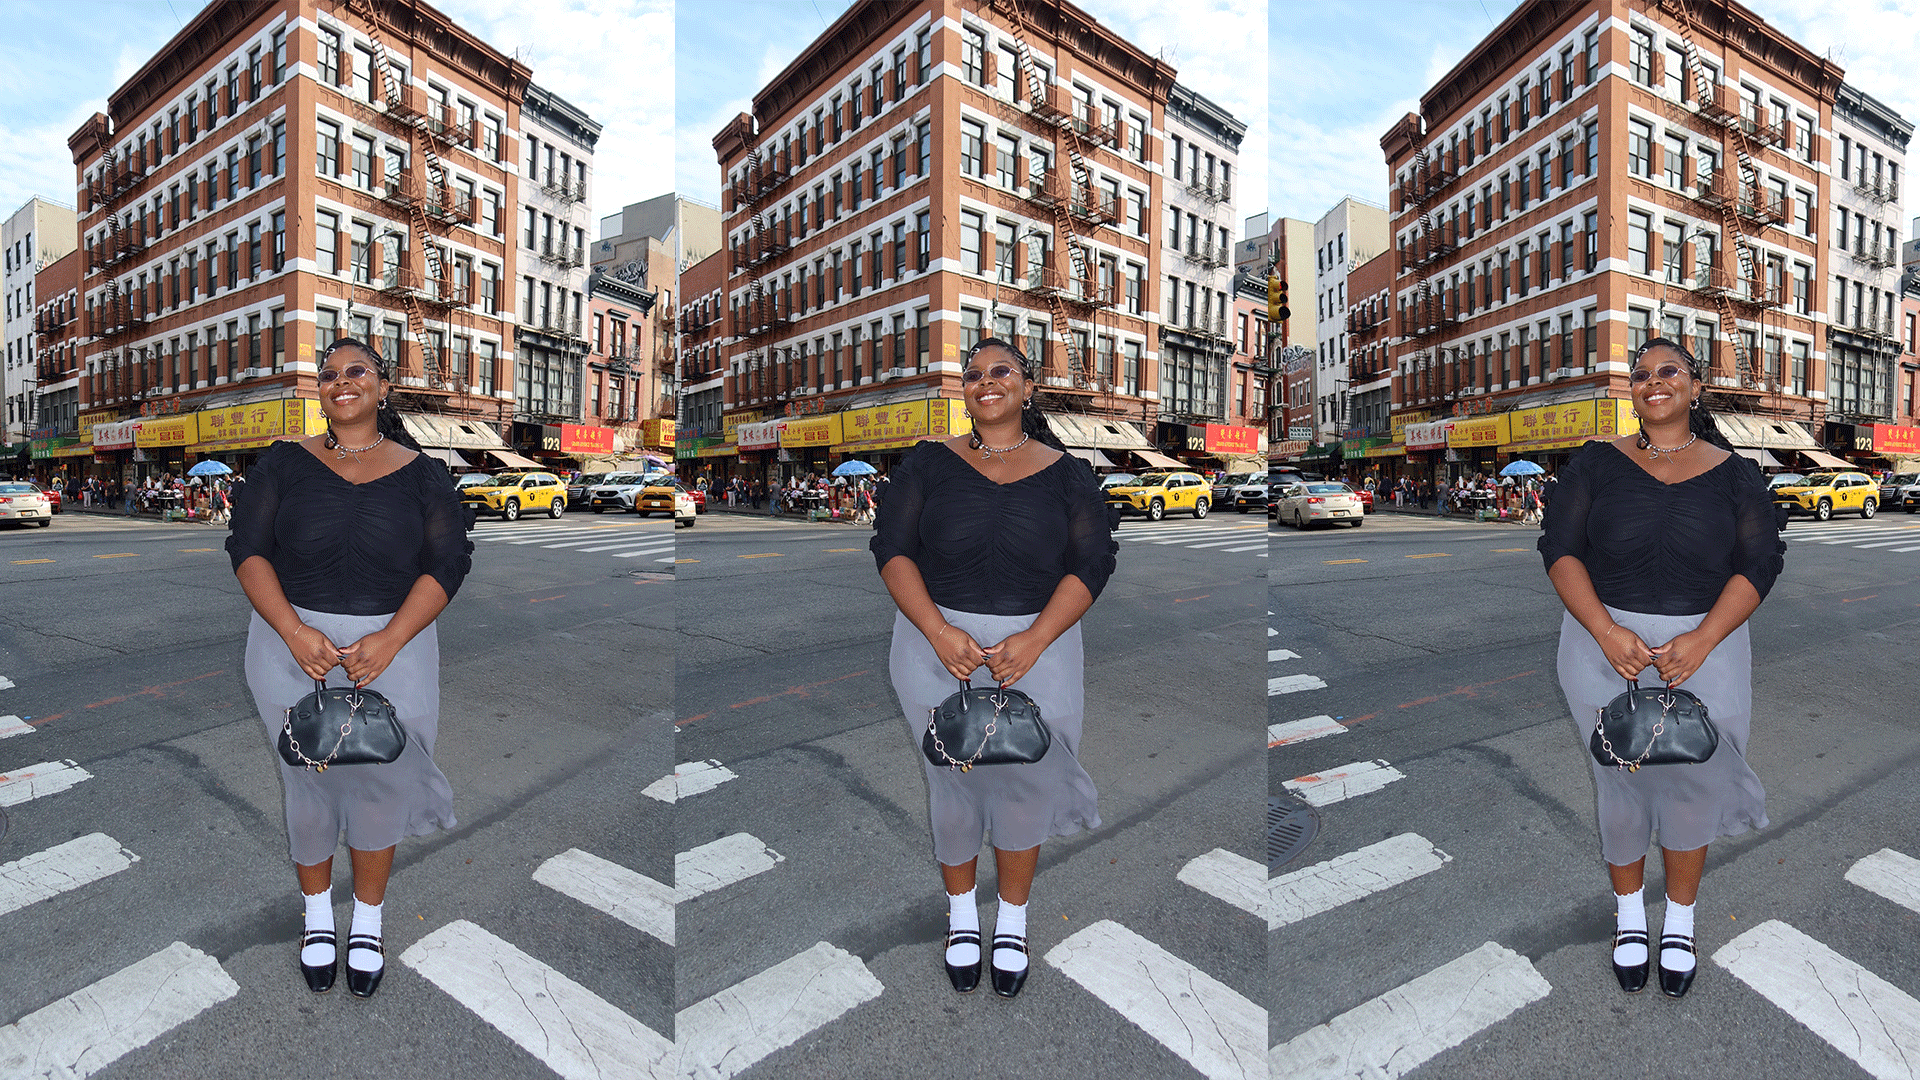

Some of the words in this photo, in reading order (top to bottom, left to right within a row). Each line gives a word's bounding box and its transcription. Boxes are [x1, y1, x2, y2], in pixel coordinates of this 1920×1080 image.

[210, 408, 269, 427] 聯豐行
[855, 408, 914, 427] 聯豐行
[1522, 408, 1581, 427] 聯豐行
[543, 436, 560, 451] 123
[1188, 436, 1205, 451] 123
[1855, 436, 1872, 451] 123
